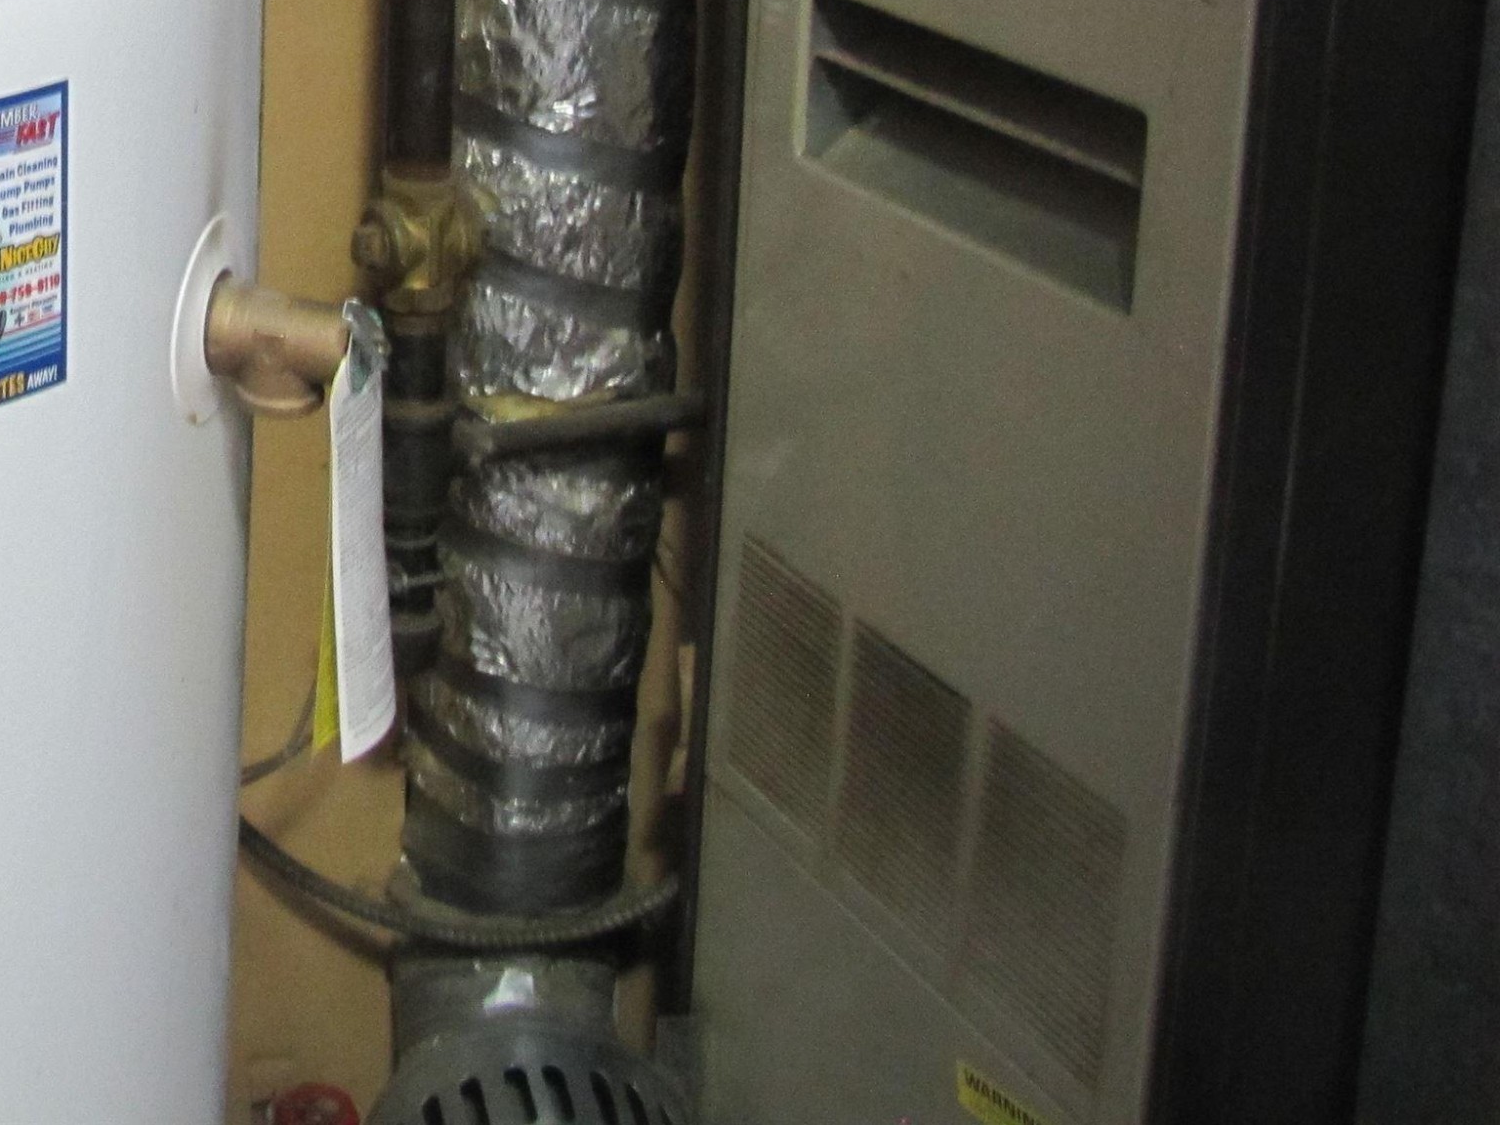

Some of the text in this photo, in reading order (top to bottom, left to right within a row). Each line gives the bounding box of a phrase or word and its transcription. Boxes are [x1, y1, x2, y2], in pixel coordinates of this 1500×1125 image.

[17, 156, 58, 178] Cleaning
[21, 196, 54, 215] Fitting
[9, 215, 54, 238] Plumbing
